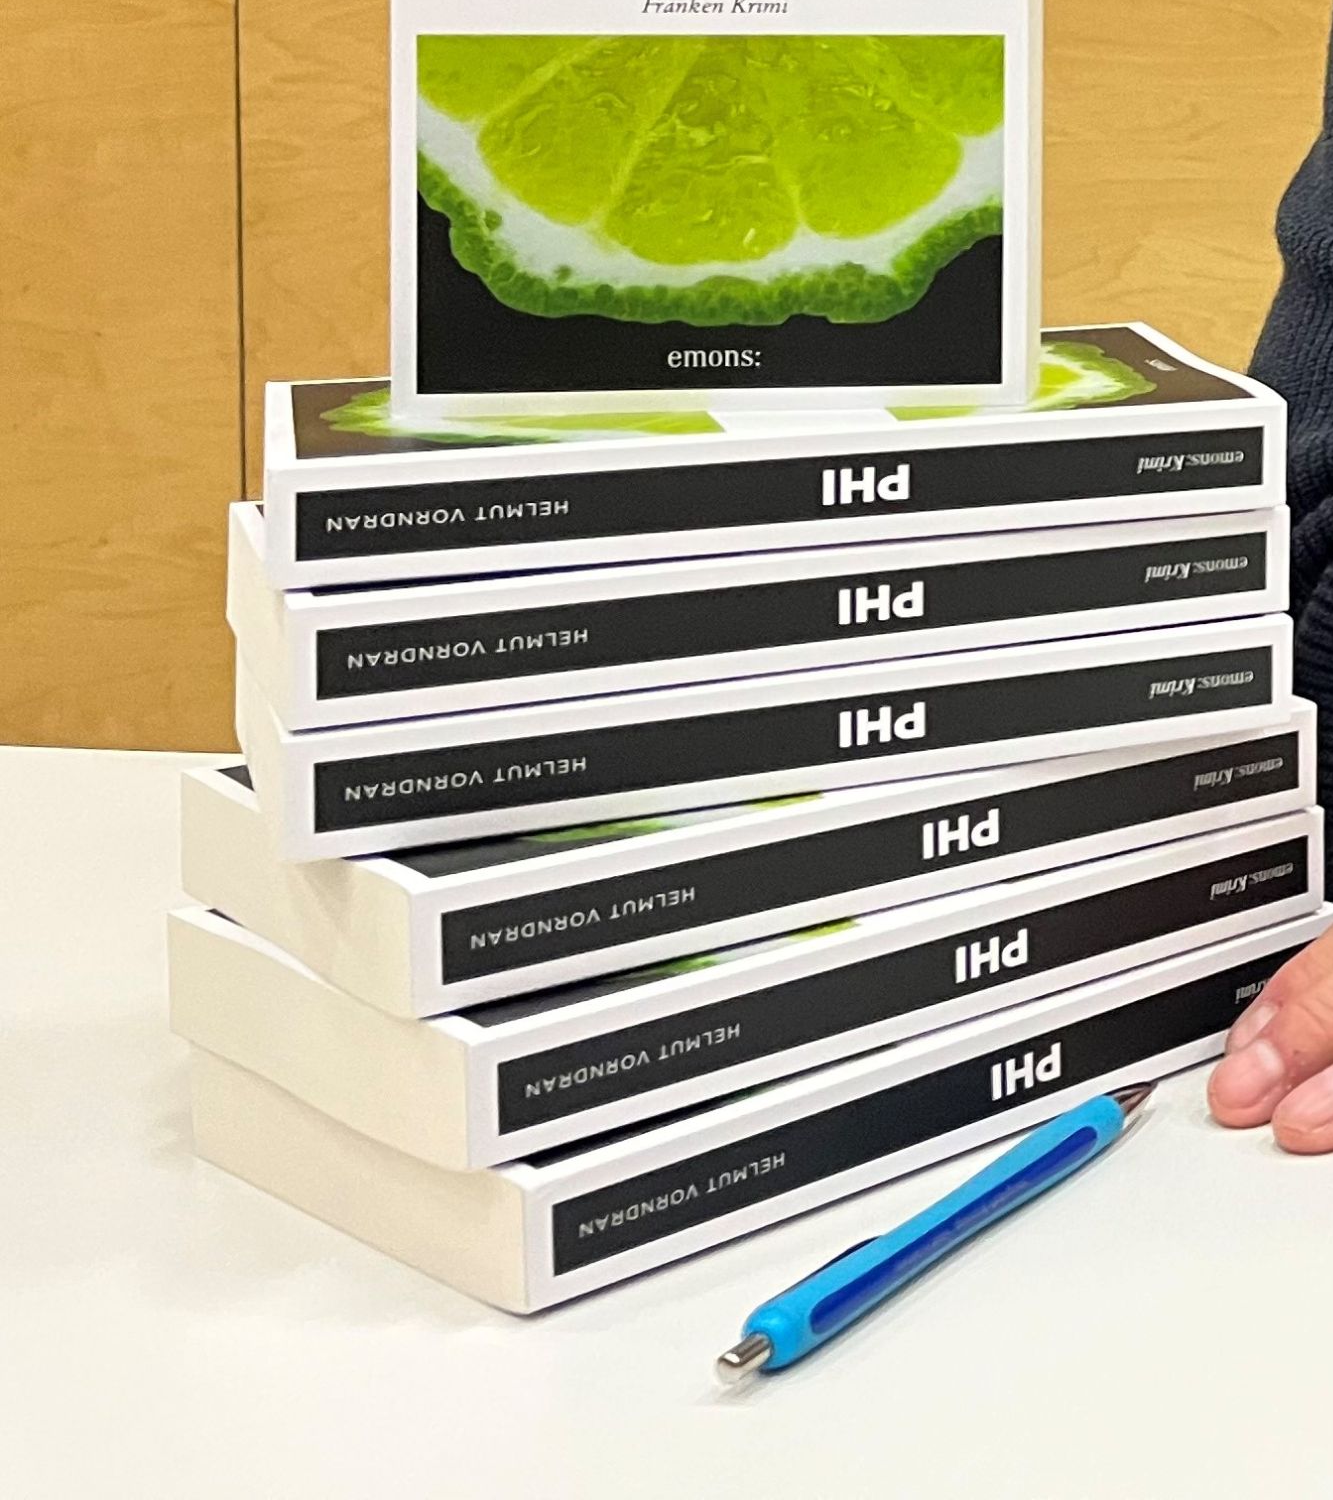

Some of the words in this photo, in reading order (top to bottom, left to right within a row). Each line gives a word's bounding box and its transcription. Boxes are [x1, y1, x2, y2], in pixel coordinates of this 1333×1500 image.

[667, 346, 761, 369] emons:
[822, 464, 910, 506] PHI
[327, 508, 464, 533] VORNDRAN
[475, 500, 569, 523] HELMUT
[838, 581, 924, 625] PHI
[347, 641, 486, 670] VORNDRAN
[496, 628, 588, 654] HELMUT
[838, 702, 926, 748] PHI
[344, 770, 484, 802] VORNDRAN
[493, 756, 587, 784] HELMUT
[922, 807, 1000, 860] PHI
[609, 886, 696, 920] HELMUT
[470, 907, 601, 951] VORNDRAN
[955, 928, 1029, 984] PHI
[1235, 979, 1267, 1004] rimi
[659, 1023, 741, 1061] HELMUT
[524, 1052, 650, 1099] VORNDRAN
[990, 1042, 1062, 1101] PHI
[707, 1152, 787, 1194] HELMUT
[578, 1183, 699, 1239] VORNDRAN
